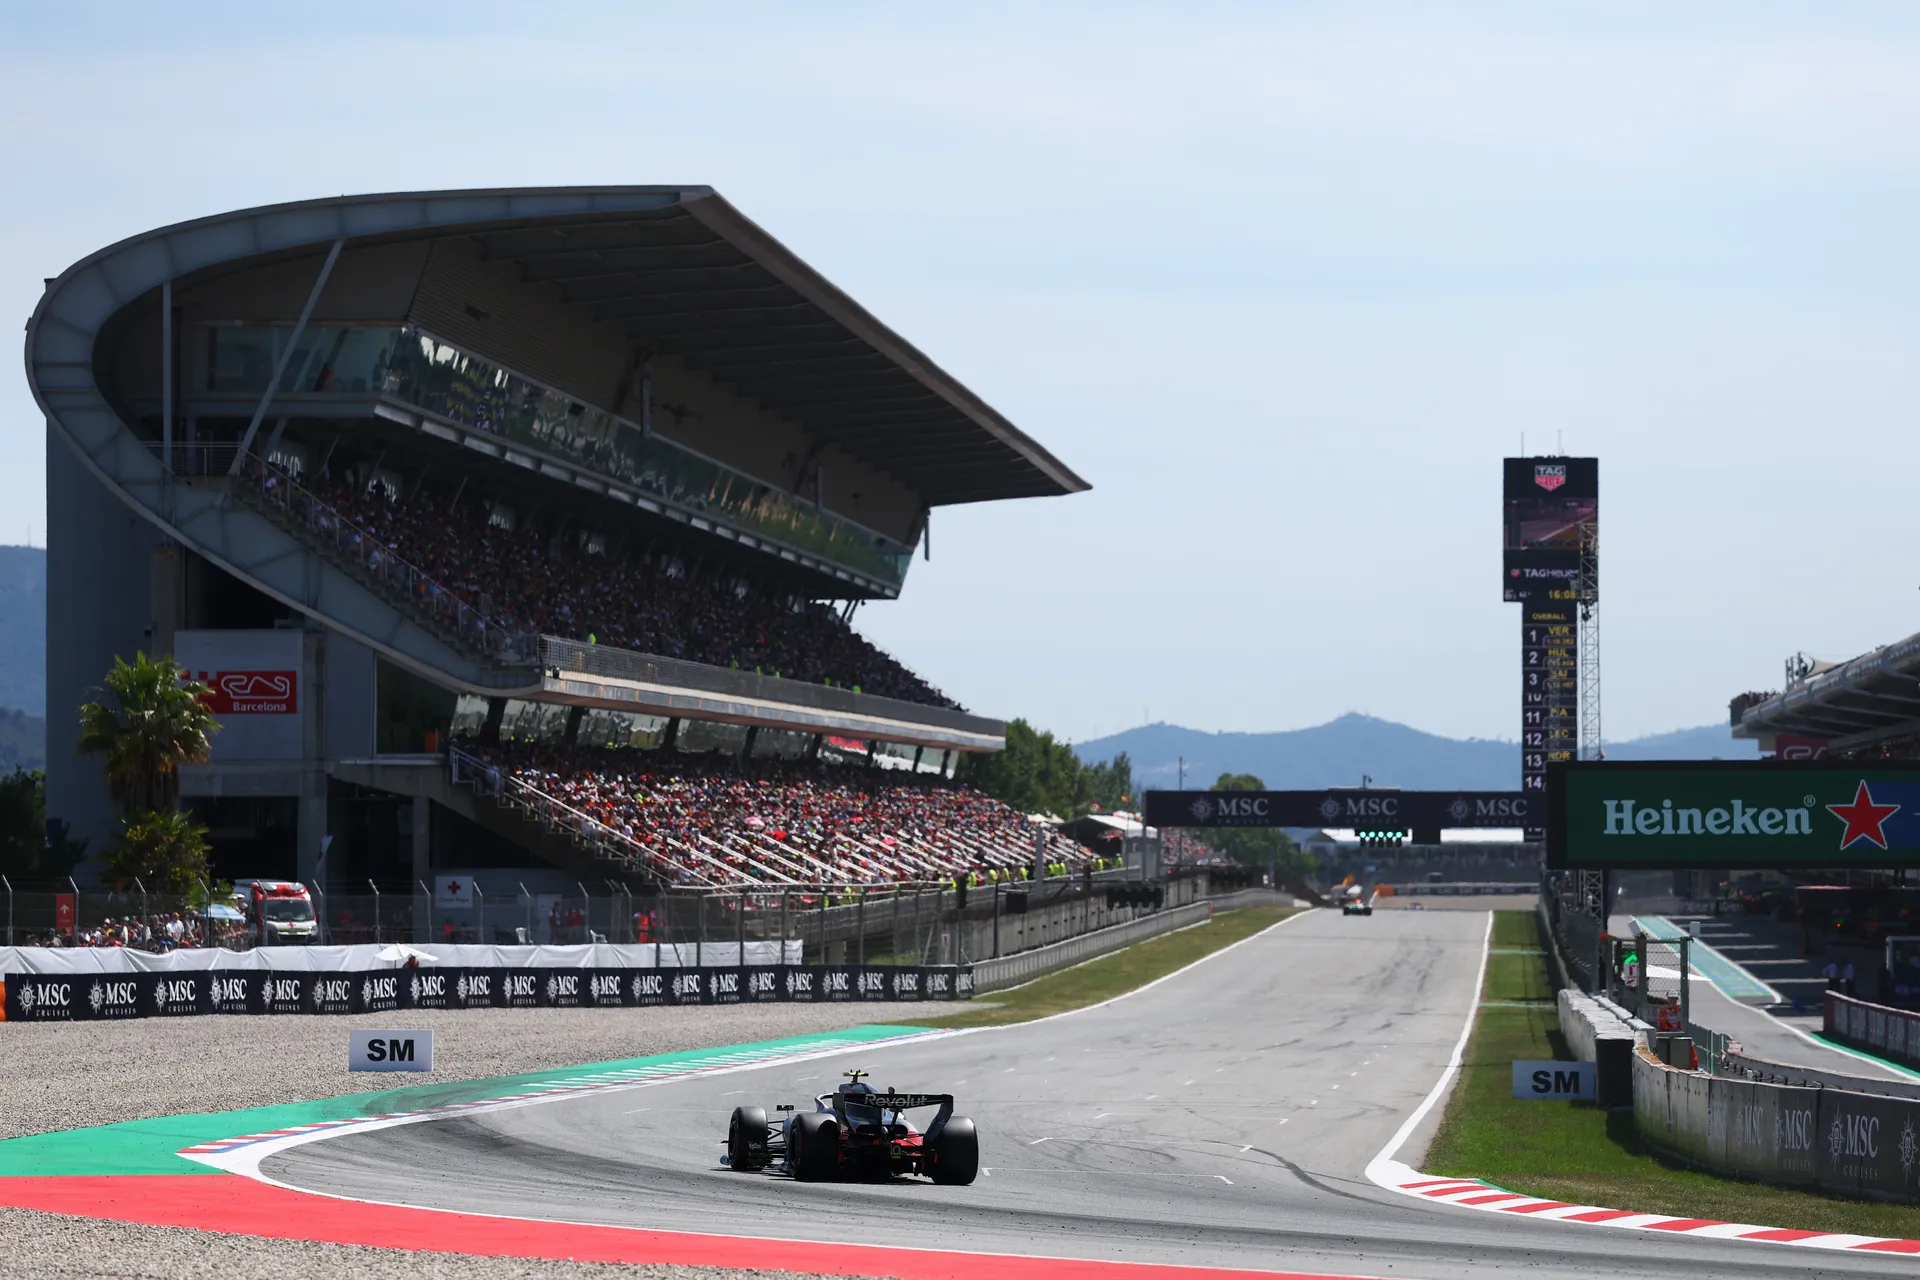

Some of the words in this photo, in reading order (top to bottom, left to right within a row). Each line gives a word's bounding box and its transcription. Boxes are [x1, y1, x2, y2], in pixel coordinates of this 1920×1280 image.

[1540, 466, 1562, 475] TAG
[1529, 629, 1537, 643] 1
[1529, 651, 1538, 664] 2
[1529, 673, 1538, 686] 3
[233, 701, 286, 712] Barcelona
[1526, 711, 1541, 723] 11
[1525, 733, 1542, 746] 12
[1526, 754, 1542, 767] 13
[1525, 776, 1542, 789] 14
[1217, 798, 1269, 816] MSC
[1346, 798, 1398, 816] MSC
[1475, 799, 1528, 816] MSC
[1603, 799, 1813, 835] Heineken
[222, 978, 247, 1000] MSC
[275, 979, 300, 1001] MSC
[326, 980, 350, 1001] MSC
[373, 977, 397, 998] MSC
[421, 975, 446, 996] MSC
[469, 975, 490, 995] MSC
[513, 975, 536, 995] MSC
[557, 975, 579, 995] MSC
[600, 975, 621, 995] MSC
[641, 975, 663, 994] MSC
[682, 974, 700, 993] MSC
[719, 973, 739, 992] MSC
[758, 972, 776, 991] MSC
[795, 972, 813, 991] MSC
[832, 972, 849, 990] MSC
[866, 972, 884, 990] MSC
[901, 973, 919, 991] MSC
[37, 983, 71, 1006] MSC
[106, 982, 137, 1005] MSC
[168, 980, 196, 1002] MSC
[36, 1009, 70, 1017] CRUISES
[105, 1007, 137, 1015] CRUISES
[367, 1038, 415, 1062] SM
[1531, 1070, 1580, 1094] SM
[864, 1094, 928, 1107] Revolut
[1744, 1105, 1763, 1145] MSC
[1785, 1109, 1812, 1150] MSC
[1846, 1114, 1880, 1158] MSC
[1843, 1164, 1878, 1180] CRUISES
